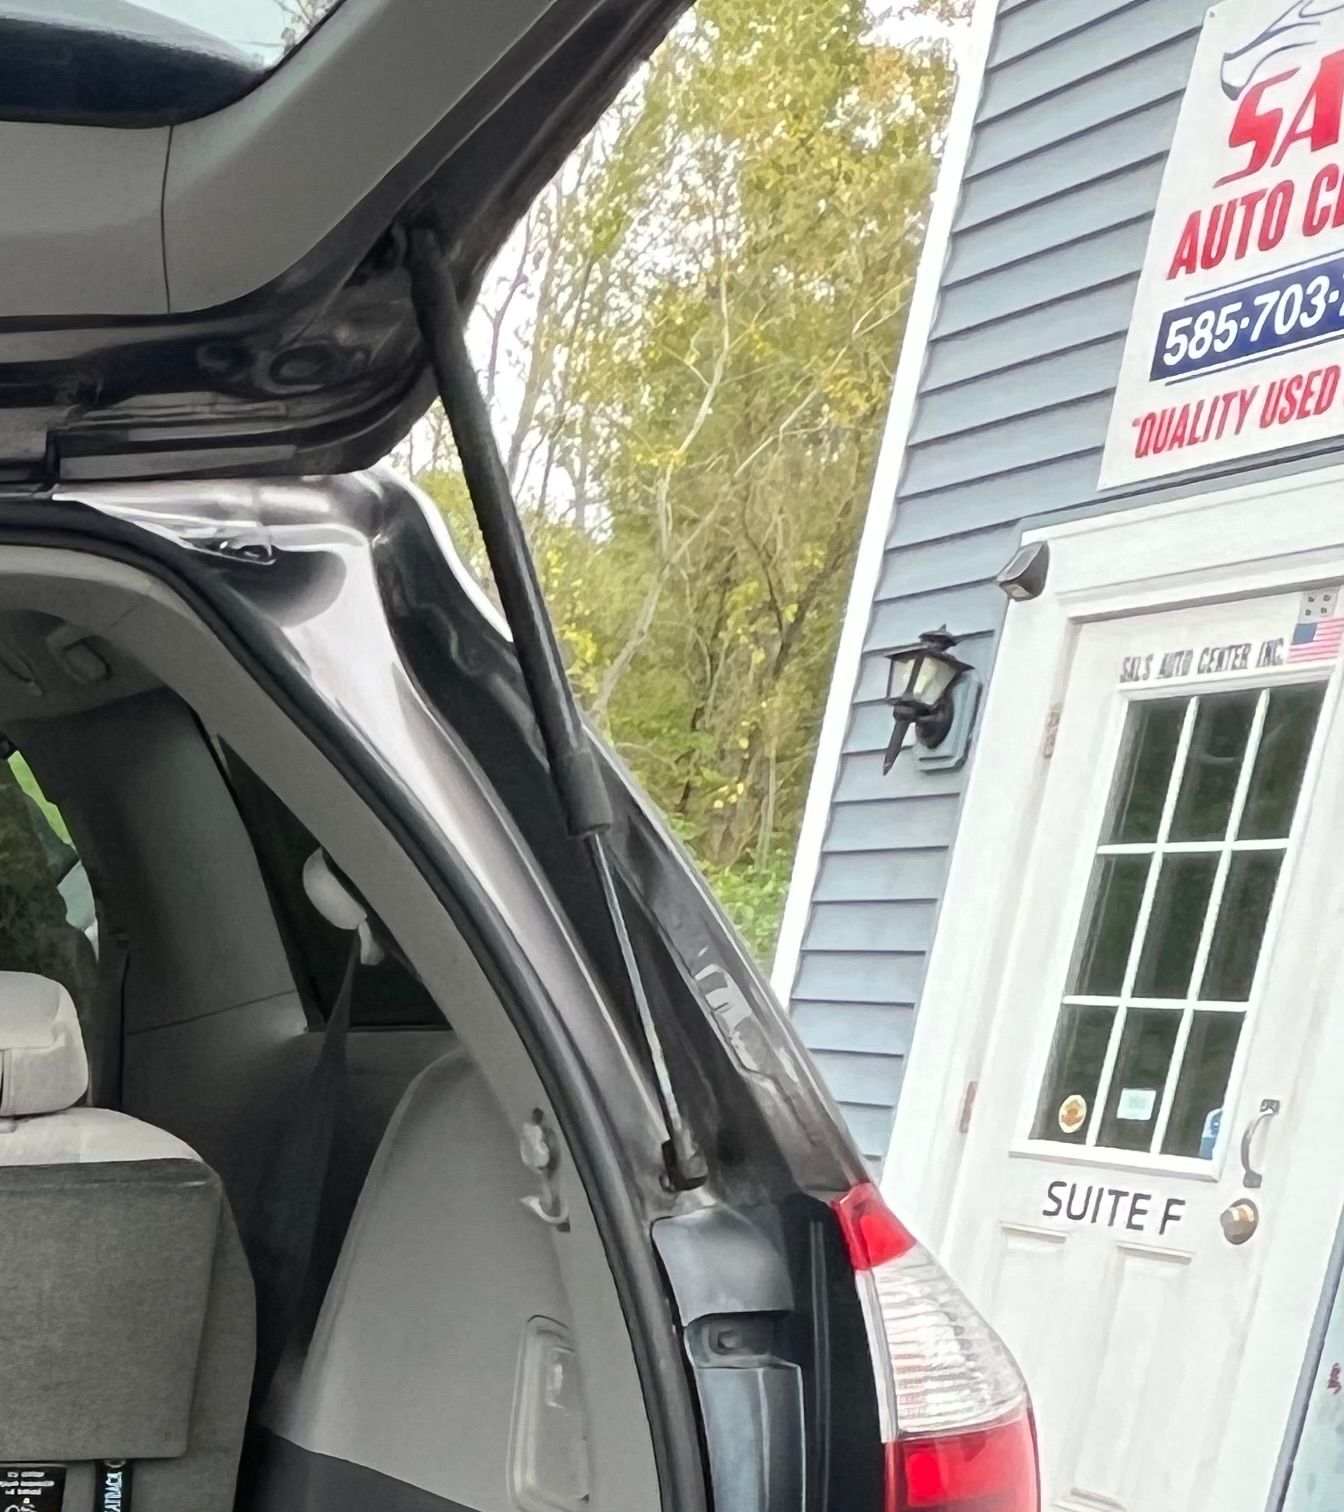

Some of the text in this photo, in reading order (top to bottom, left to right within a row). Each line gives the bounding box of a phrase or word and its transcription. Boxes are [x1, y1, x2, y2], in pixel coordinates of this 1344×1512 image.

[1166, 180, 1295, 280] AUTO
[1162, 273, 1344, 366] 585-703-
[1259, 364, 1342, 429] USED
[1197, 643, 1252, 675] CENTER
[1042, 1181, 1186, 1235] SUITE F
